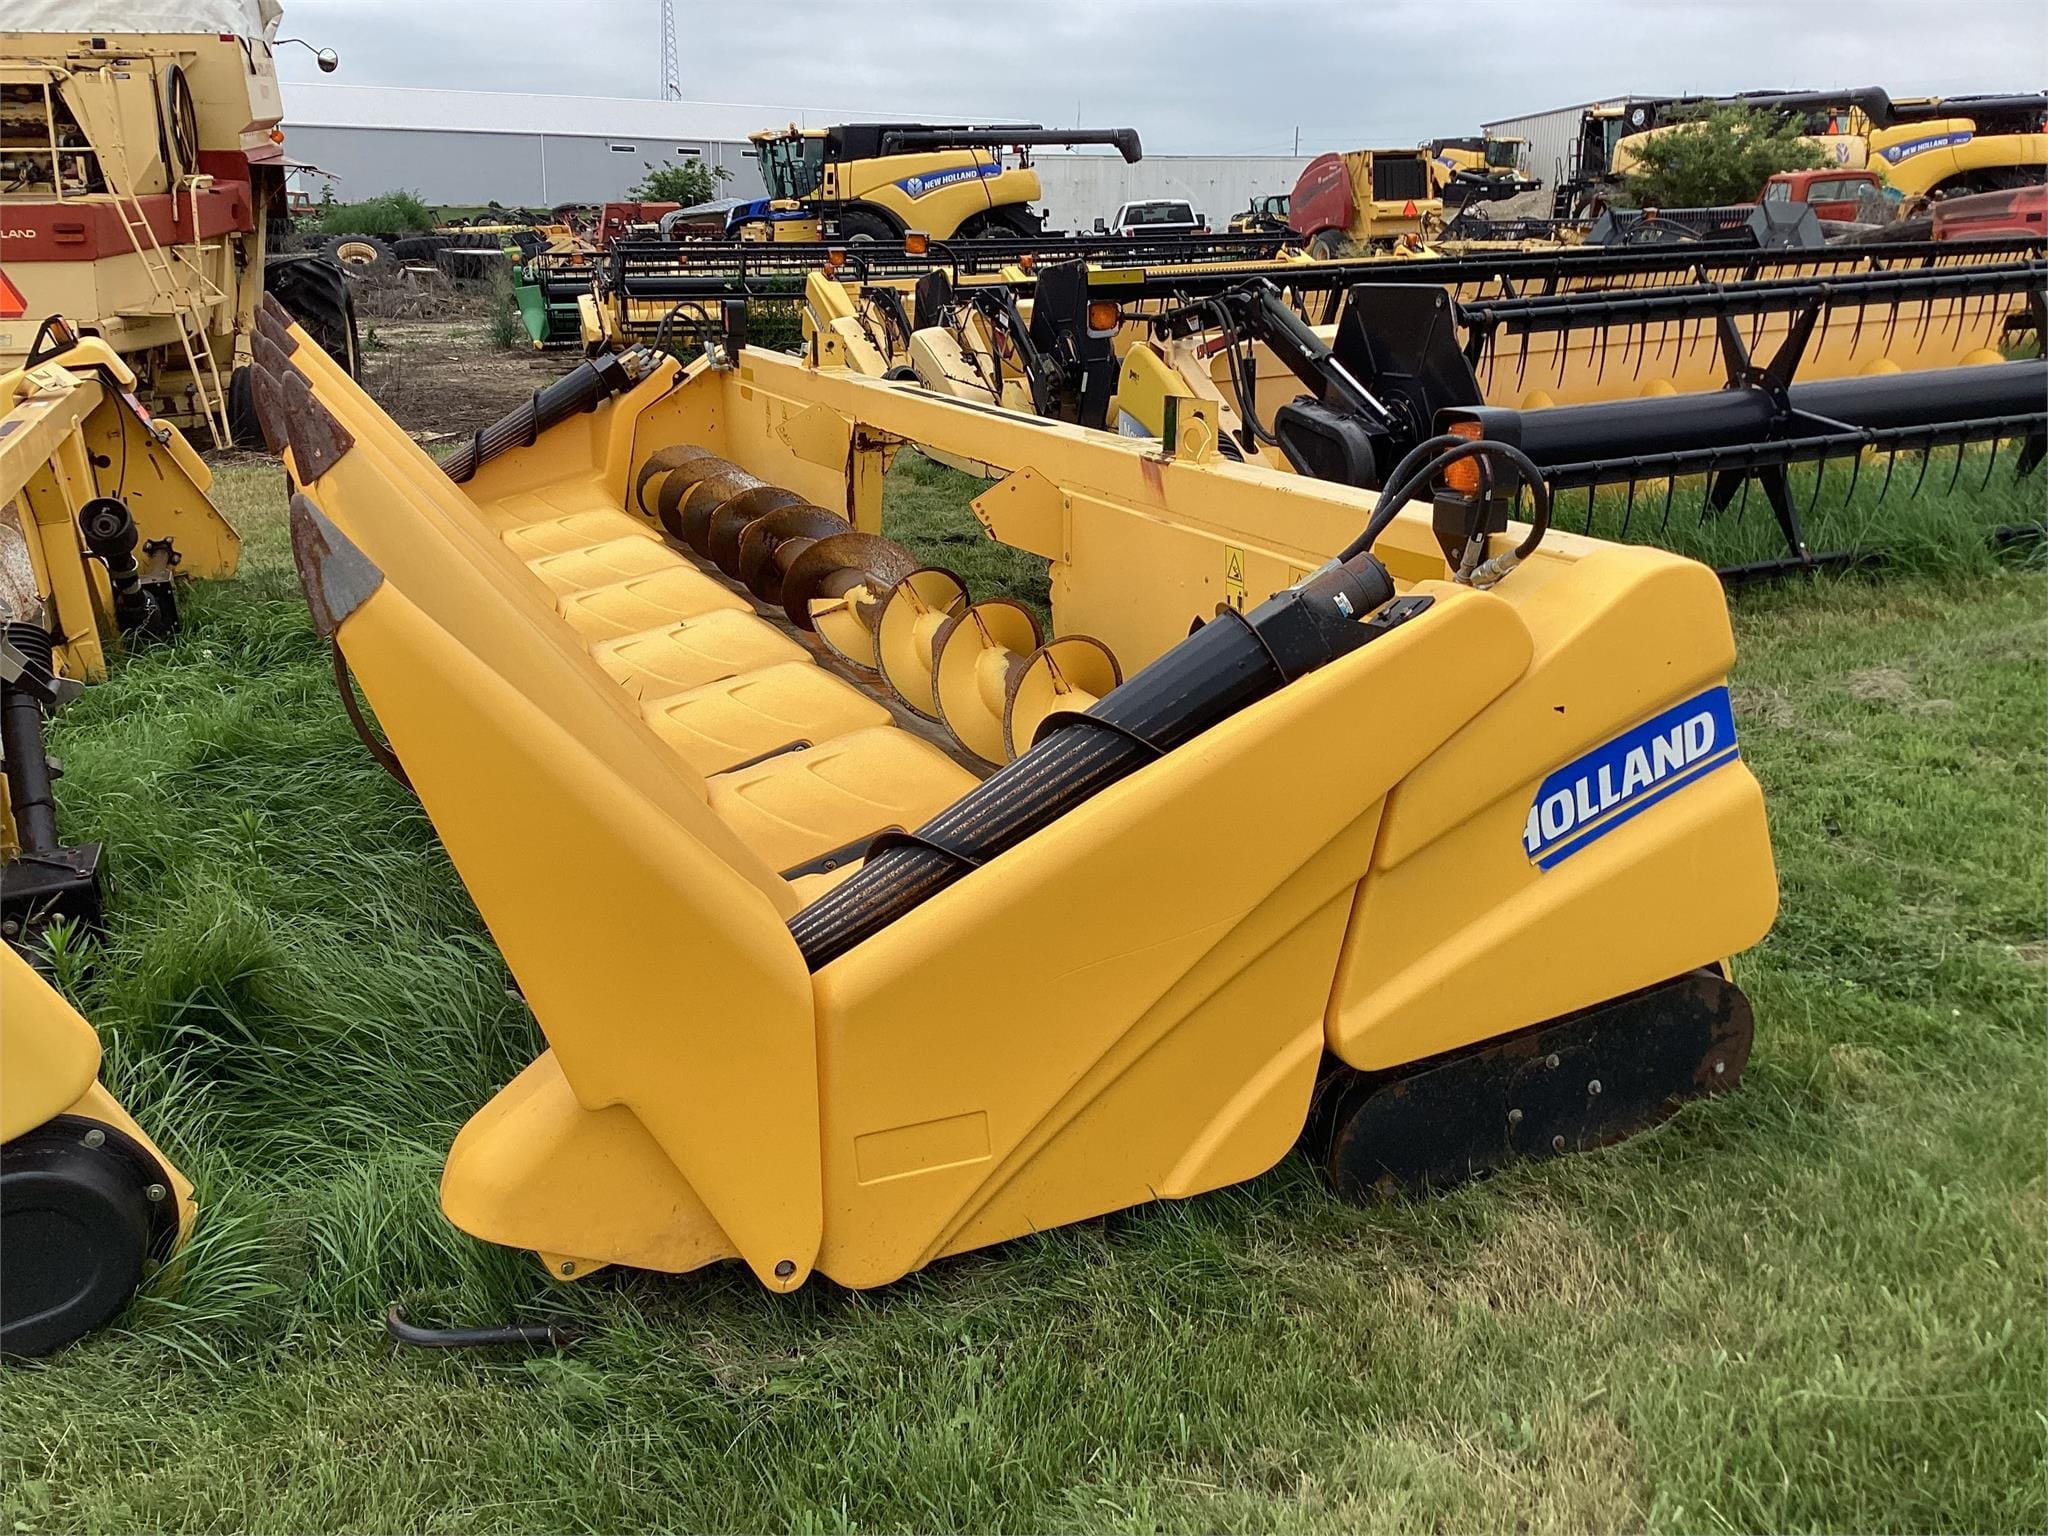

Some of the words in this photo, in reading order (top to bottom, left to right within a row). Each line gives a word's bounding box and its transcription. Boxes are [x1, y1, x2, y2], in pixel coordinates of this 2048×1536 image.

[1902, 146, 1918, 157] NEW
[1918, 138, 1949, 151] HOLLAND
[924, 178, 942, 190] NEW
[942, 170, 977, 184] HOLLAND
